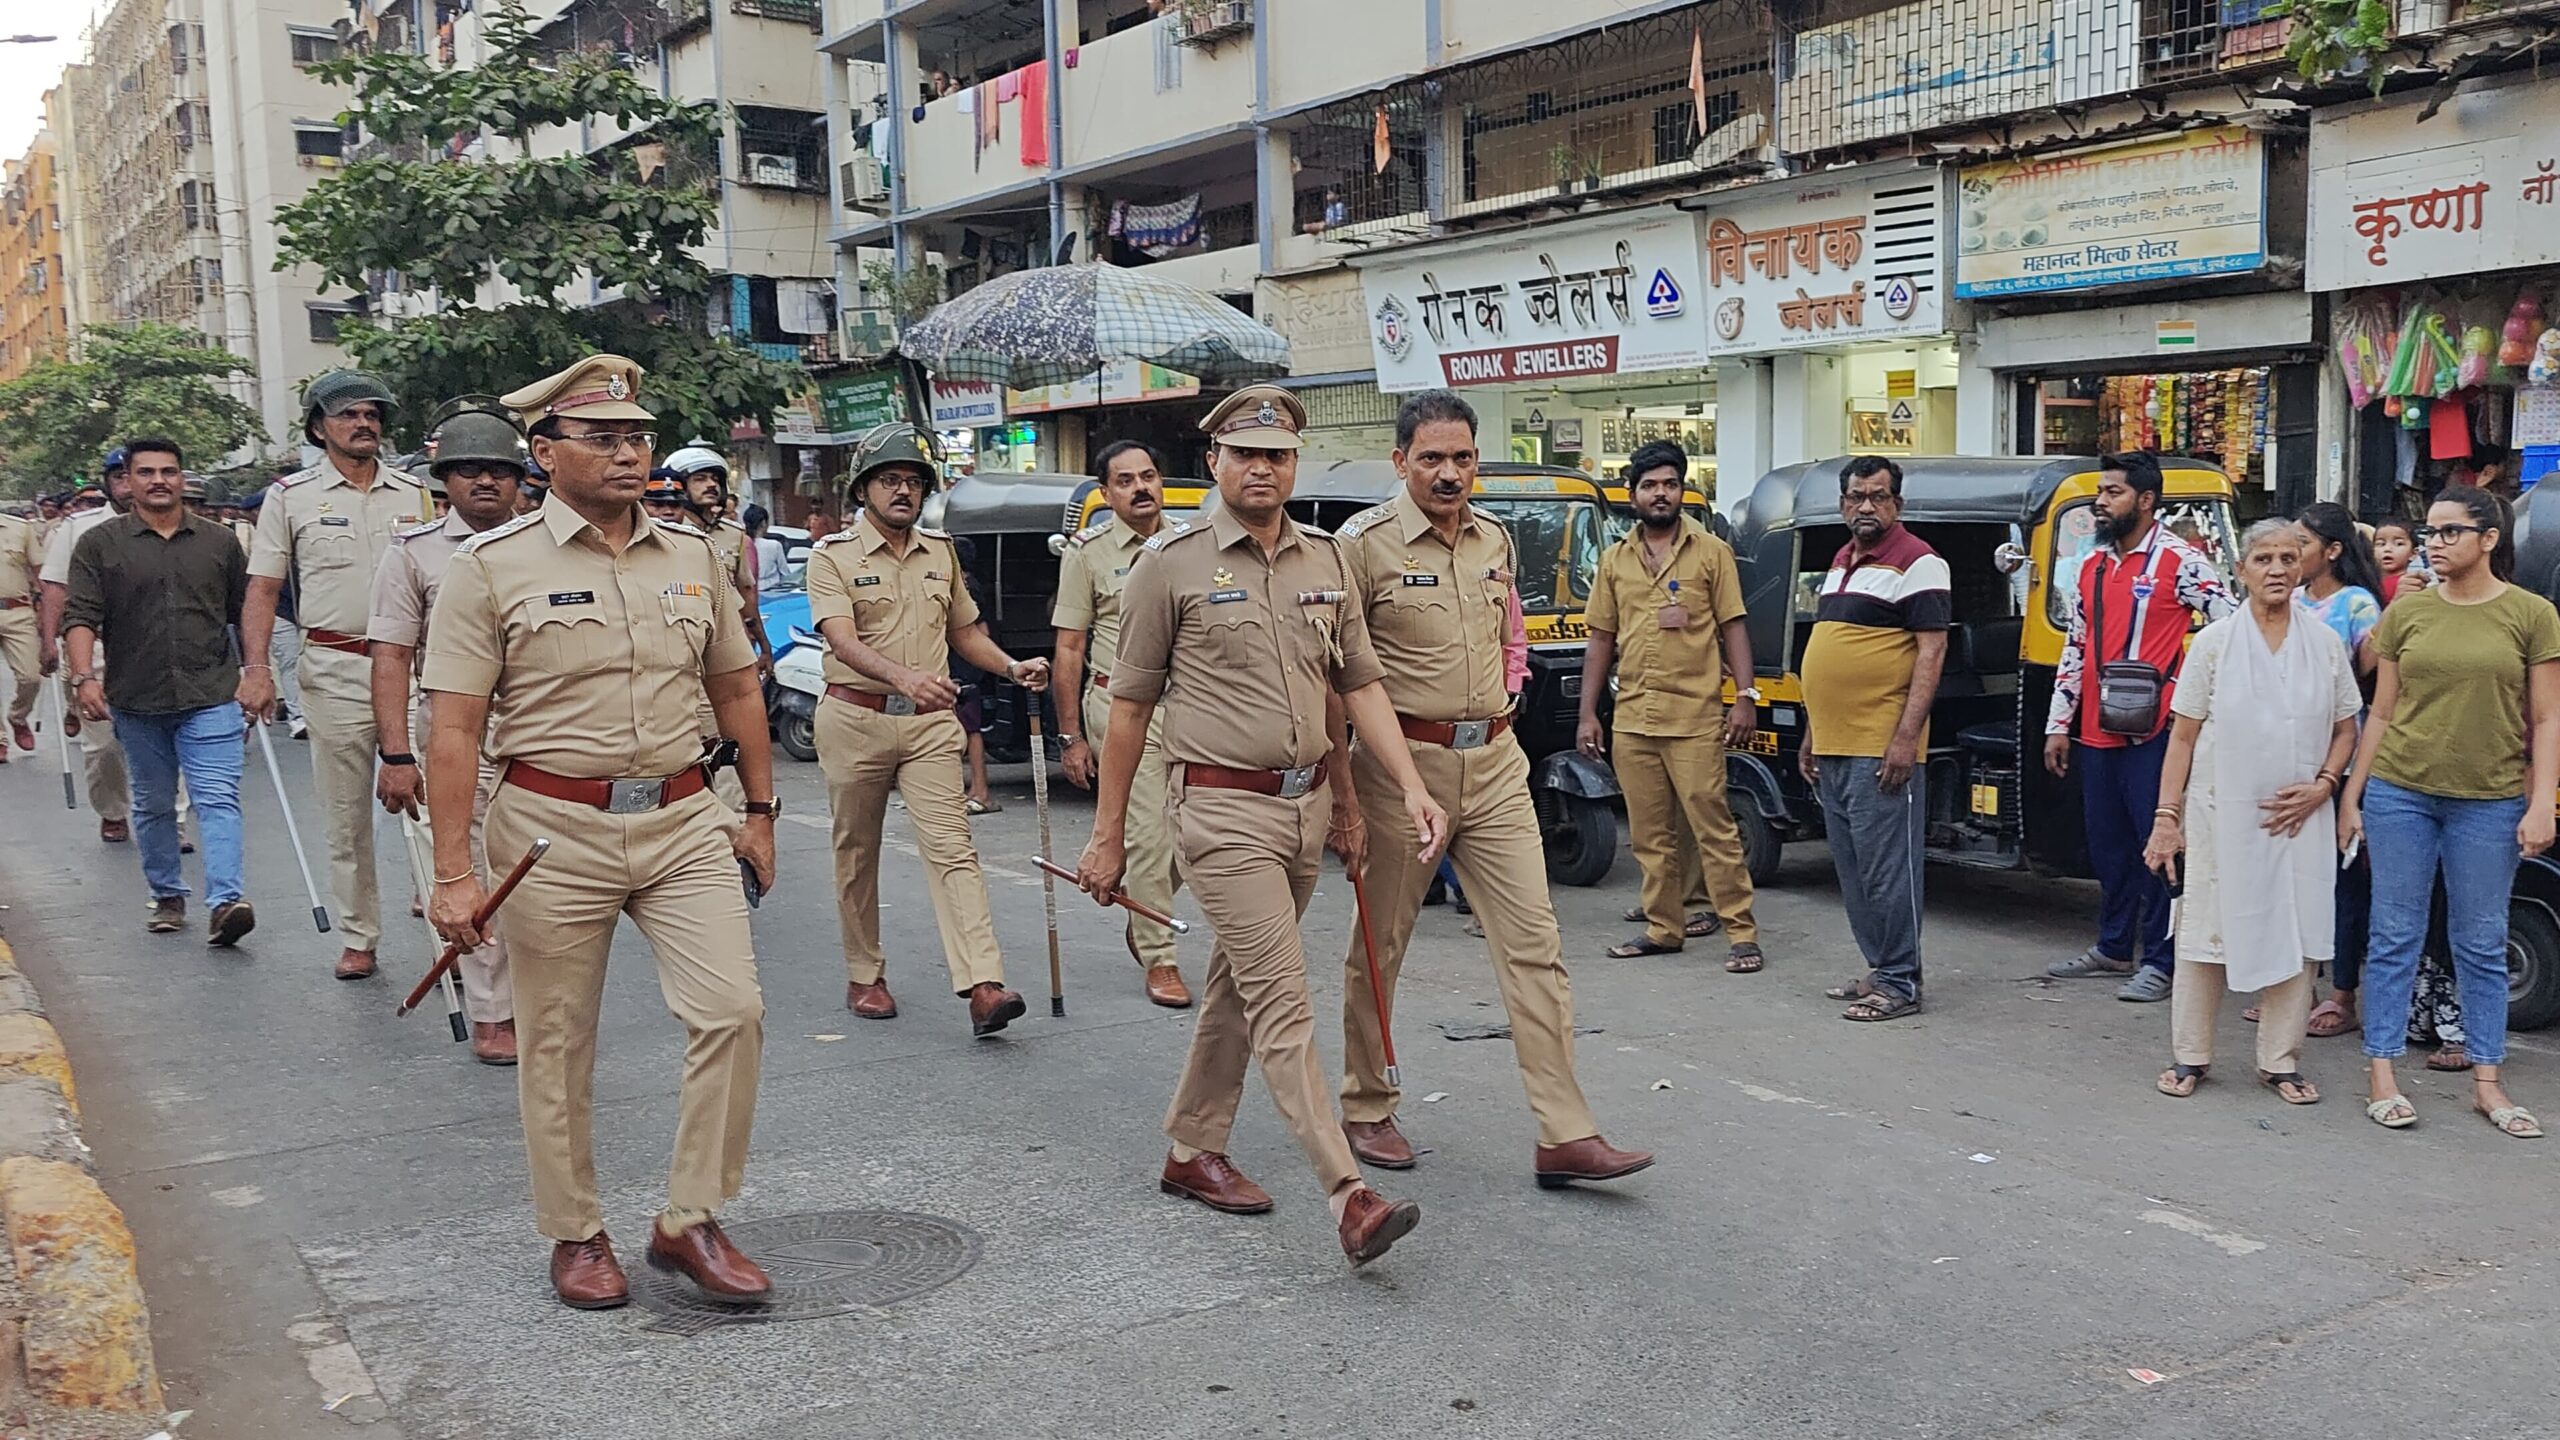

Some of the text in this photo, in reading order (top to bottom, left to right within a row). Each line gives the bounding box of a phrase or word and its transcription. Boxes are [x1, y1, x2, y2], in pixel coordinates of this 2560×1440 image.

[1707, 216, 1867, 287] विनायक
[2353, 181, 2490, 266] कृष्णा
[2021, 239, 2180, 272] महानन्द मिल्क सेन्टर
[1416, 271, 1506, 344] रोनक
[1518, 239, 1635, 330] ज्वेलर्स
[1778, 280, 1867, 332] ज्वेलर्स
[1450, 352, 1506, 382] RONAK
[1512, 342, 1609, 376] JEWELLERS
